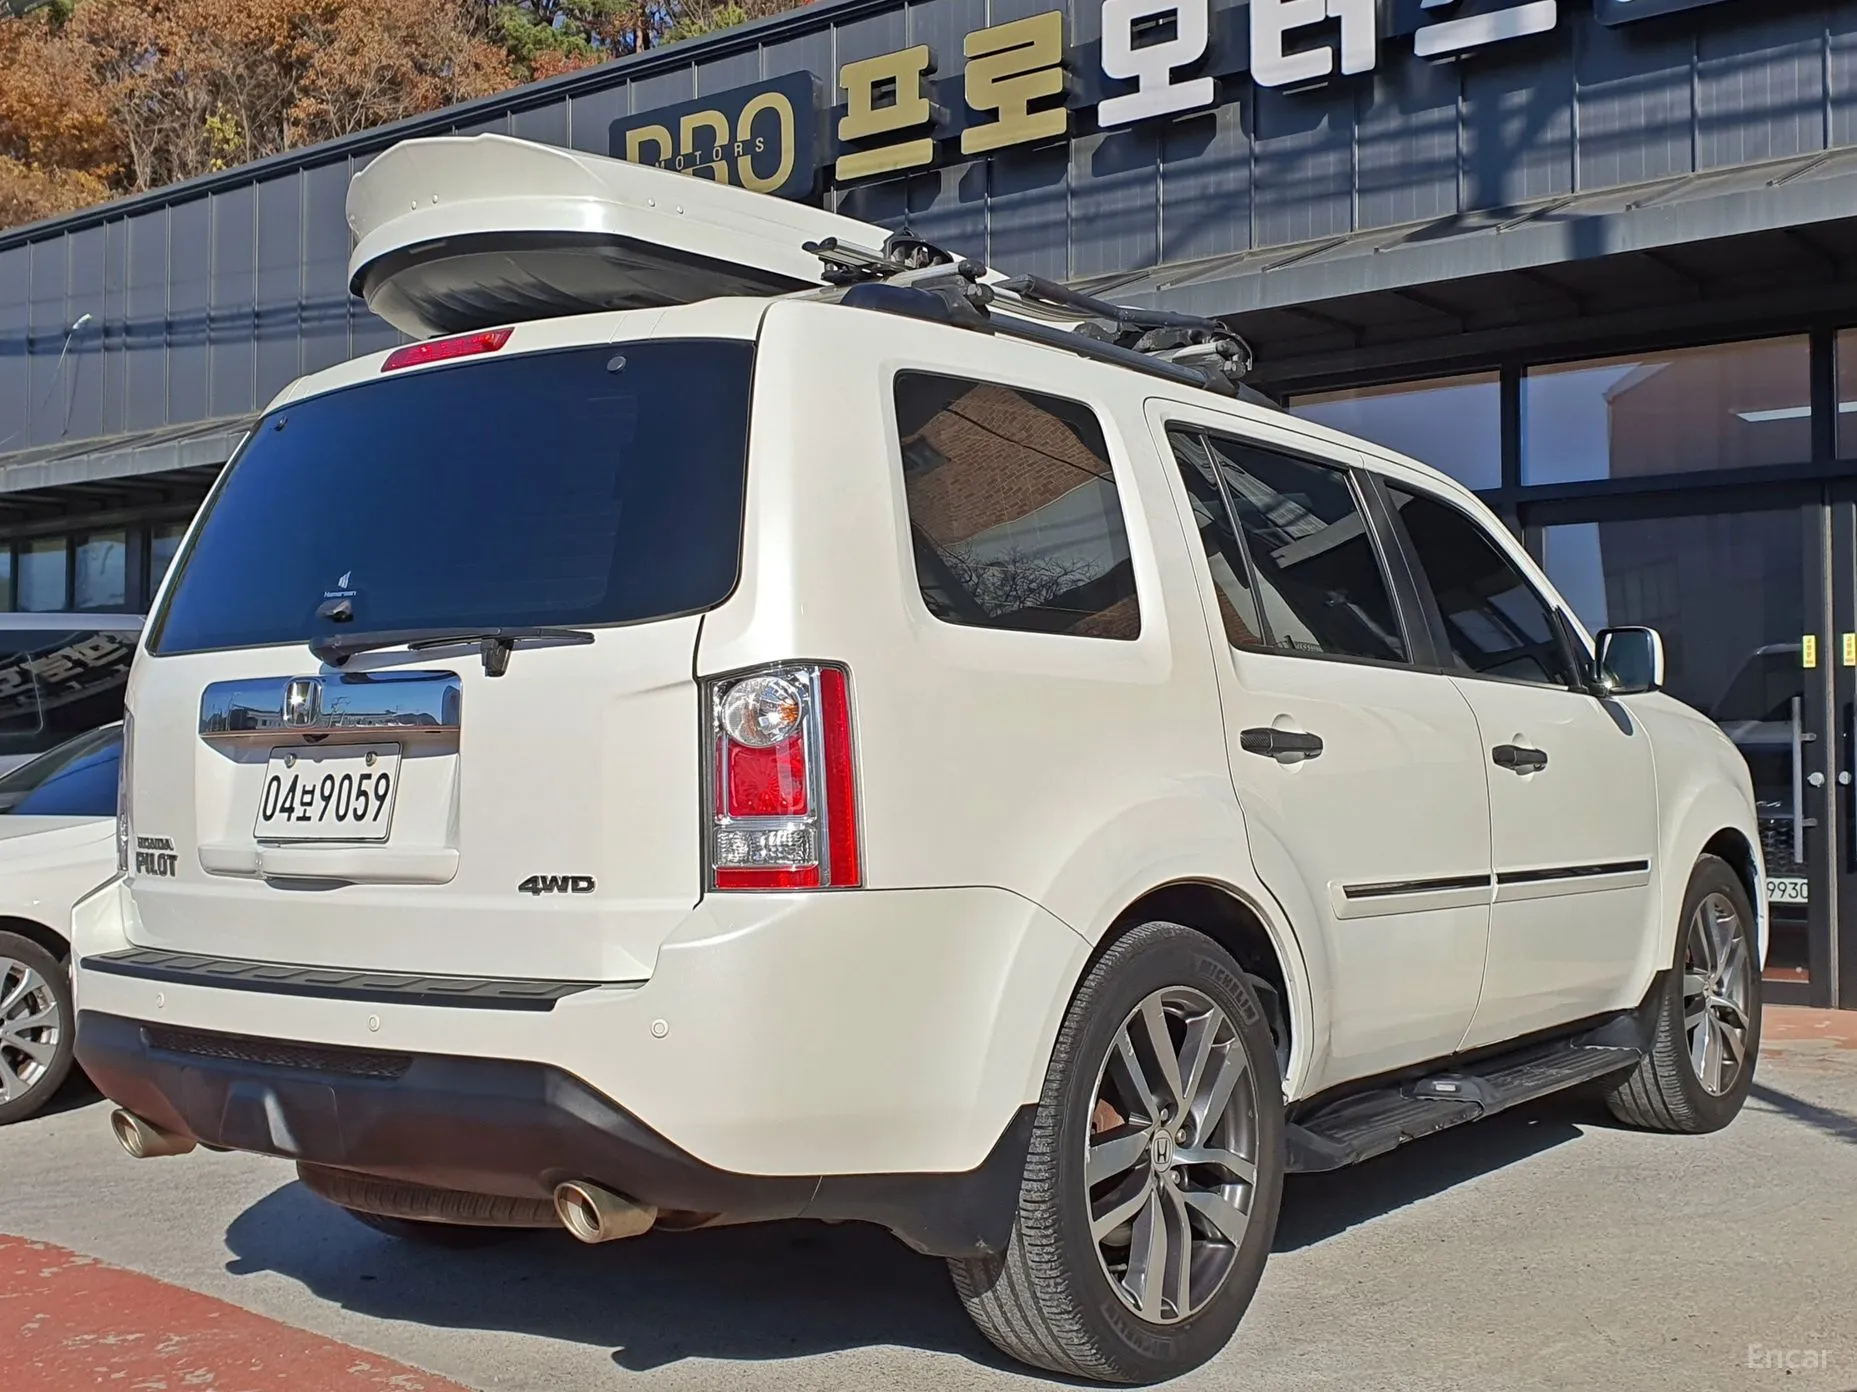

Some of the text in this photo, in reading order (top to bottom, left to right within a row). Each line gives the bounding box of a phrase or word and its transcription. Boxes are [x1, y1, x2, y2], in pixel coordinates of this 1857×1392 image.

[262, 772, 391, 822] 04보9059
[135, 851, 178, 878] PILOT
[518, 875, 595, 897] 4WD
